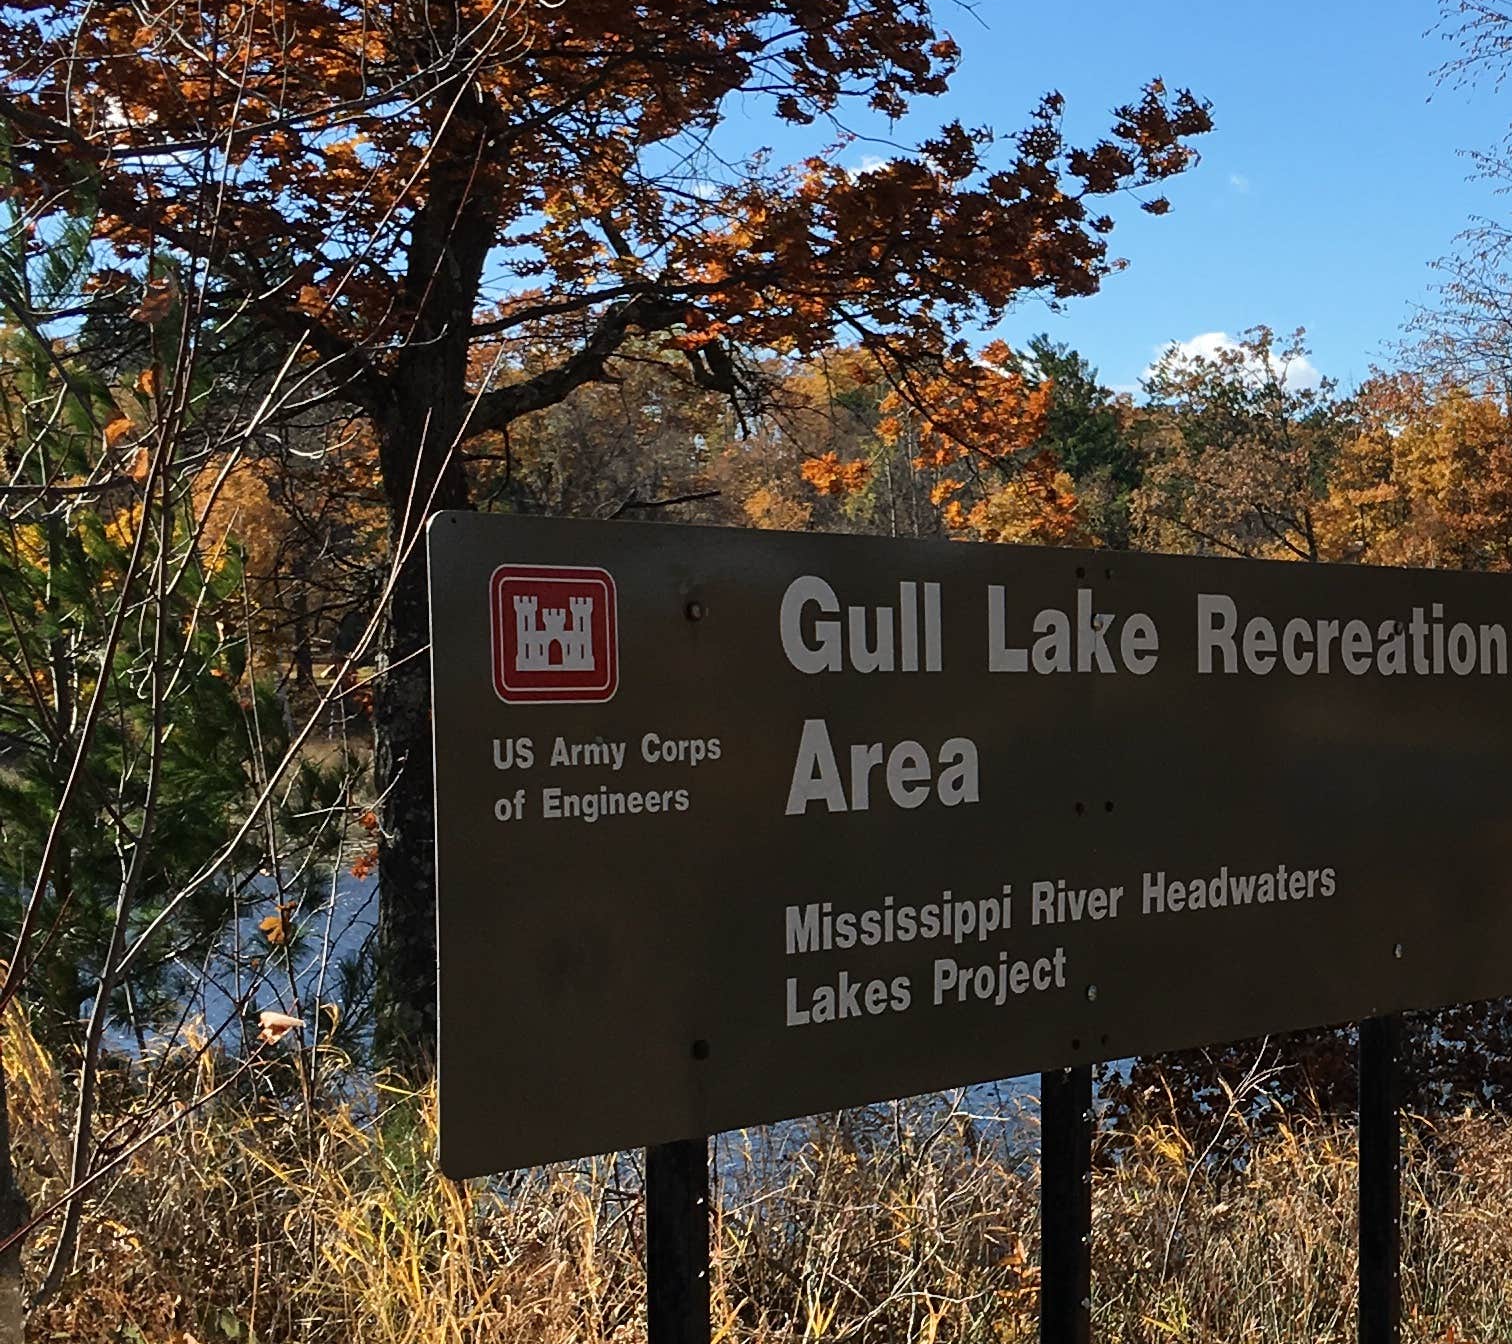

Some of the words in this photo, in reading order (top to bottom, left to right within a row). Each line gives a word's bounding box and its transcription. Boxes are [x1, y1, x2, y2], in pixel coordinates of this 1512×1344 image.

[779, 575, 942, 674] Gull
[987, 584, 1159, 675] Lake
[1197, 593, 1508, 676] Recreation
[492, 737, 534, 770] US
[550, 736, 626, 771] Army
[641, 732, 722, 766] Corps
[784, 719, 980, 816] Area
[494, 789, 526, 821] of
[542, 785, 690, 823] Engineers
[785, 884, 1012, 955] Mississippi
[1031, 879, 1124, 926] River
[1142, 864, 1336, 914] Headwaters
[786, 971, 911, 1027] Lakes
[933, 947, 1067, 1006] Project
